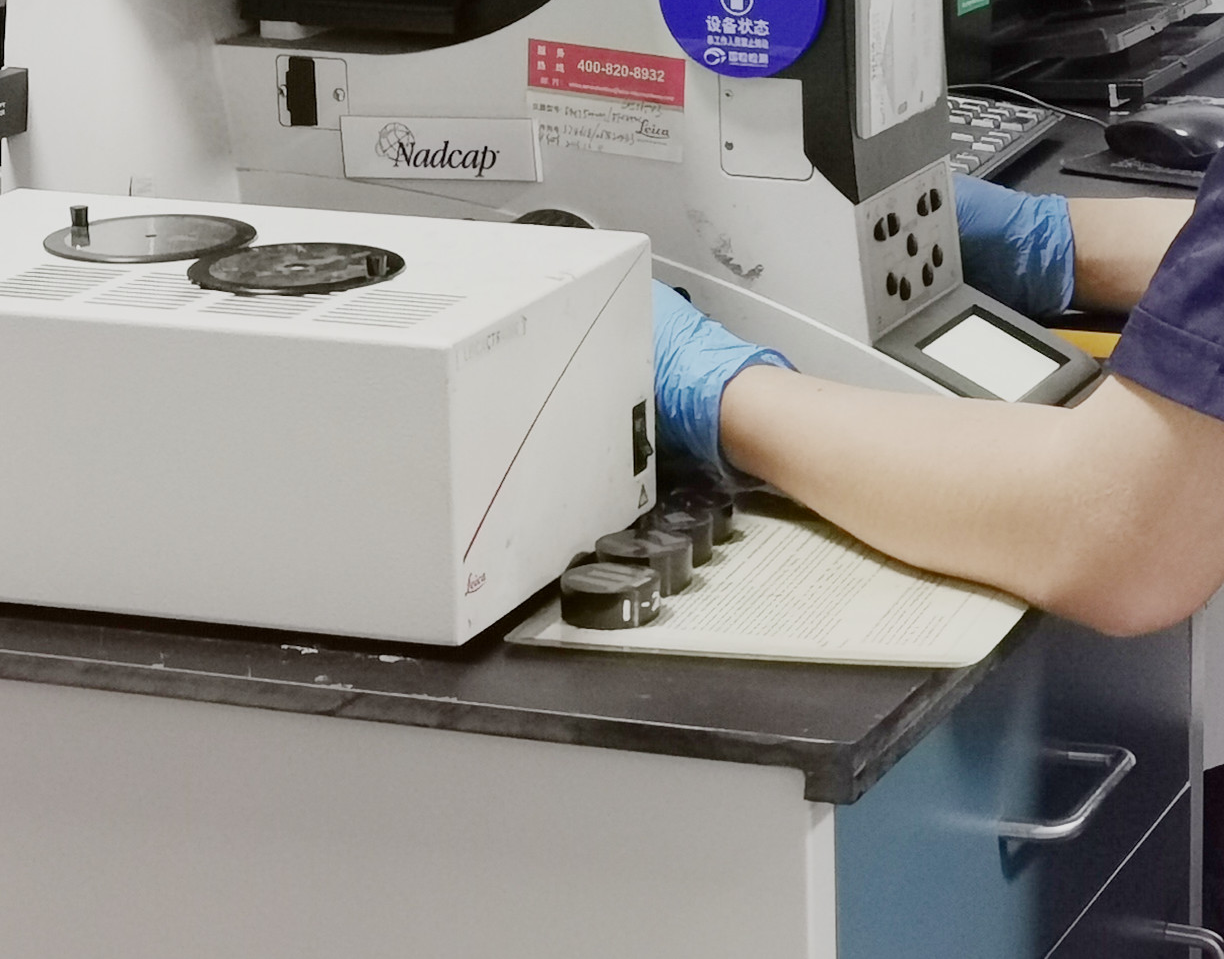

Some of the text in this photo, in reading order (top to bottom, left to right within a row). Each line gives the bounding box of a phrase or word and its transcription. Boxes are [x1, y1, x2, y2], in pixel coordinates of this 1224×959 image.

[705, 15, 770, 37] 设备状态
[577, 59, 665, 83] 400-820-8932
[635, 119, 670, 139] Leica
[393, 140, 498, 178] Nadcap
[464, 572, 487, 597] Leica
